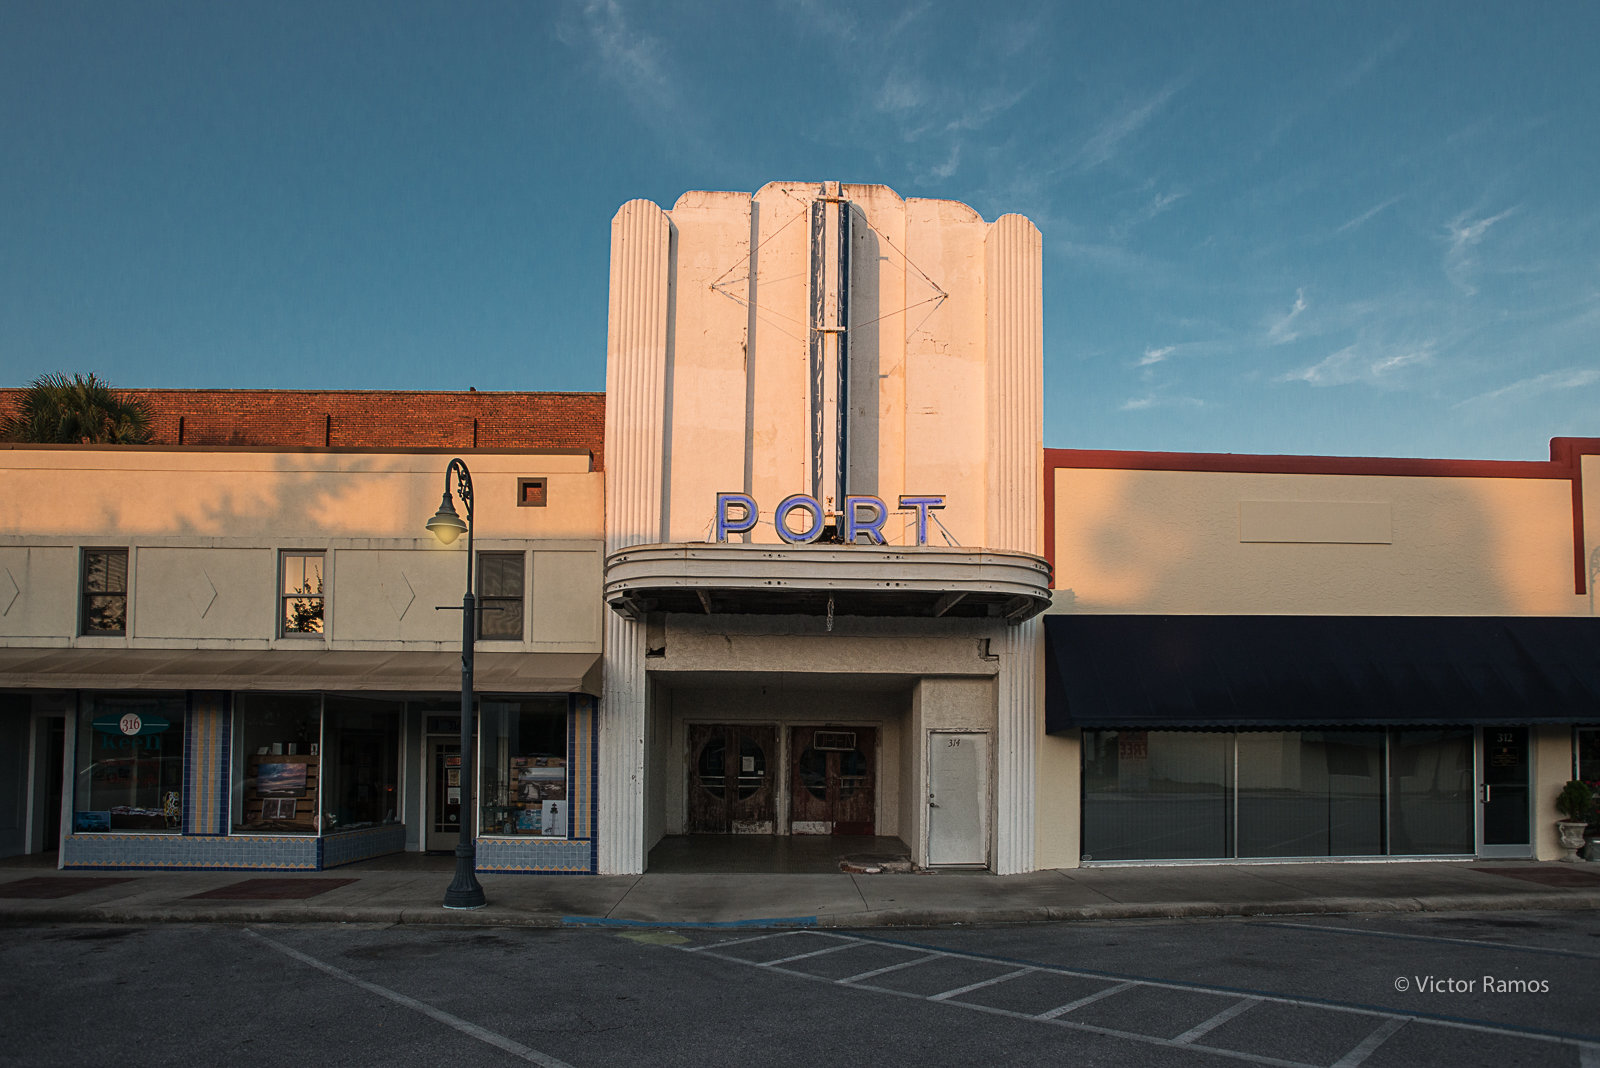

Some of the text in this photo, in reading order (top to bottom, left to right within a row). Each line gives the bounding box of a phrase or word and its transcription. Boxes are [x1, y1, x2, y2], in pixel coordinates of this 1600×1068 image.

[716, 492, 947, 545] PORT
[122, 717, 140, 732] 316
[948, 739, 961, 748] 314
[1497, 733, 1513, 743] 312
